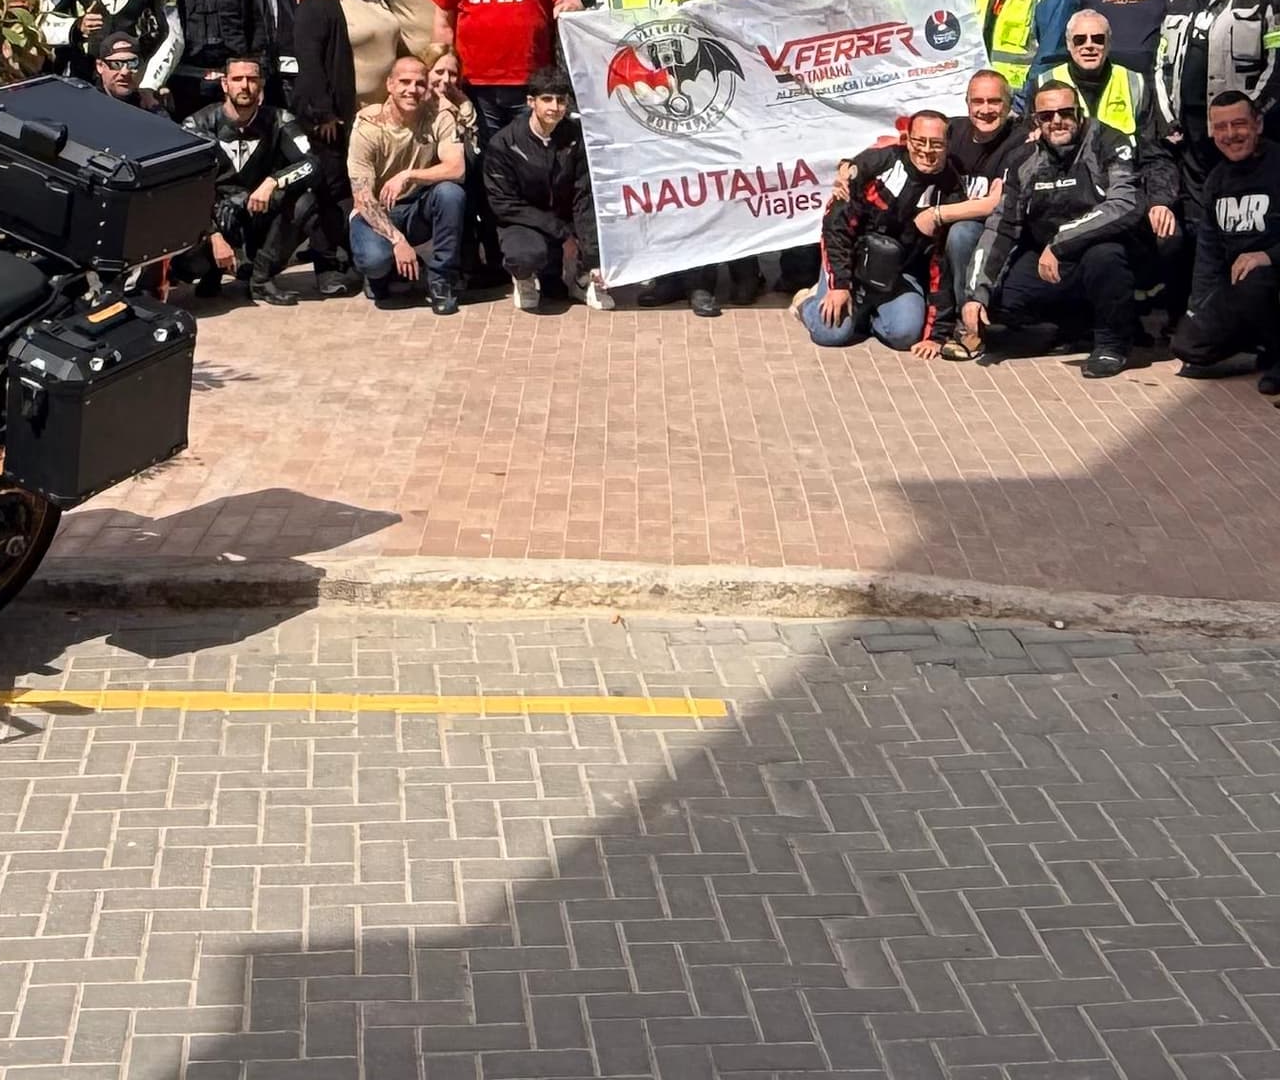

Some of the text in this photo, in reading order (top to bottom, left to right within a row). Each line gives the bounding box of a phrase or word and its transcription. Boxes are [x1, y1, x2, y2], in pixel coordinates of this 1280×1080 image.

[622, 158, 820, 217] NAUTALIA
[744, 191, 823, 219] Viajes
[1215, 193, 1270, 232] VMR
